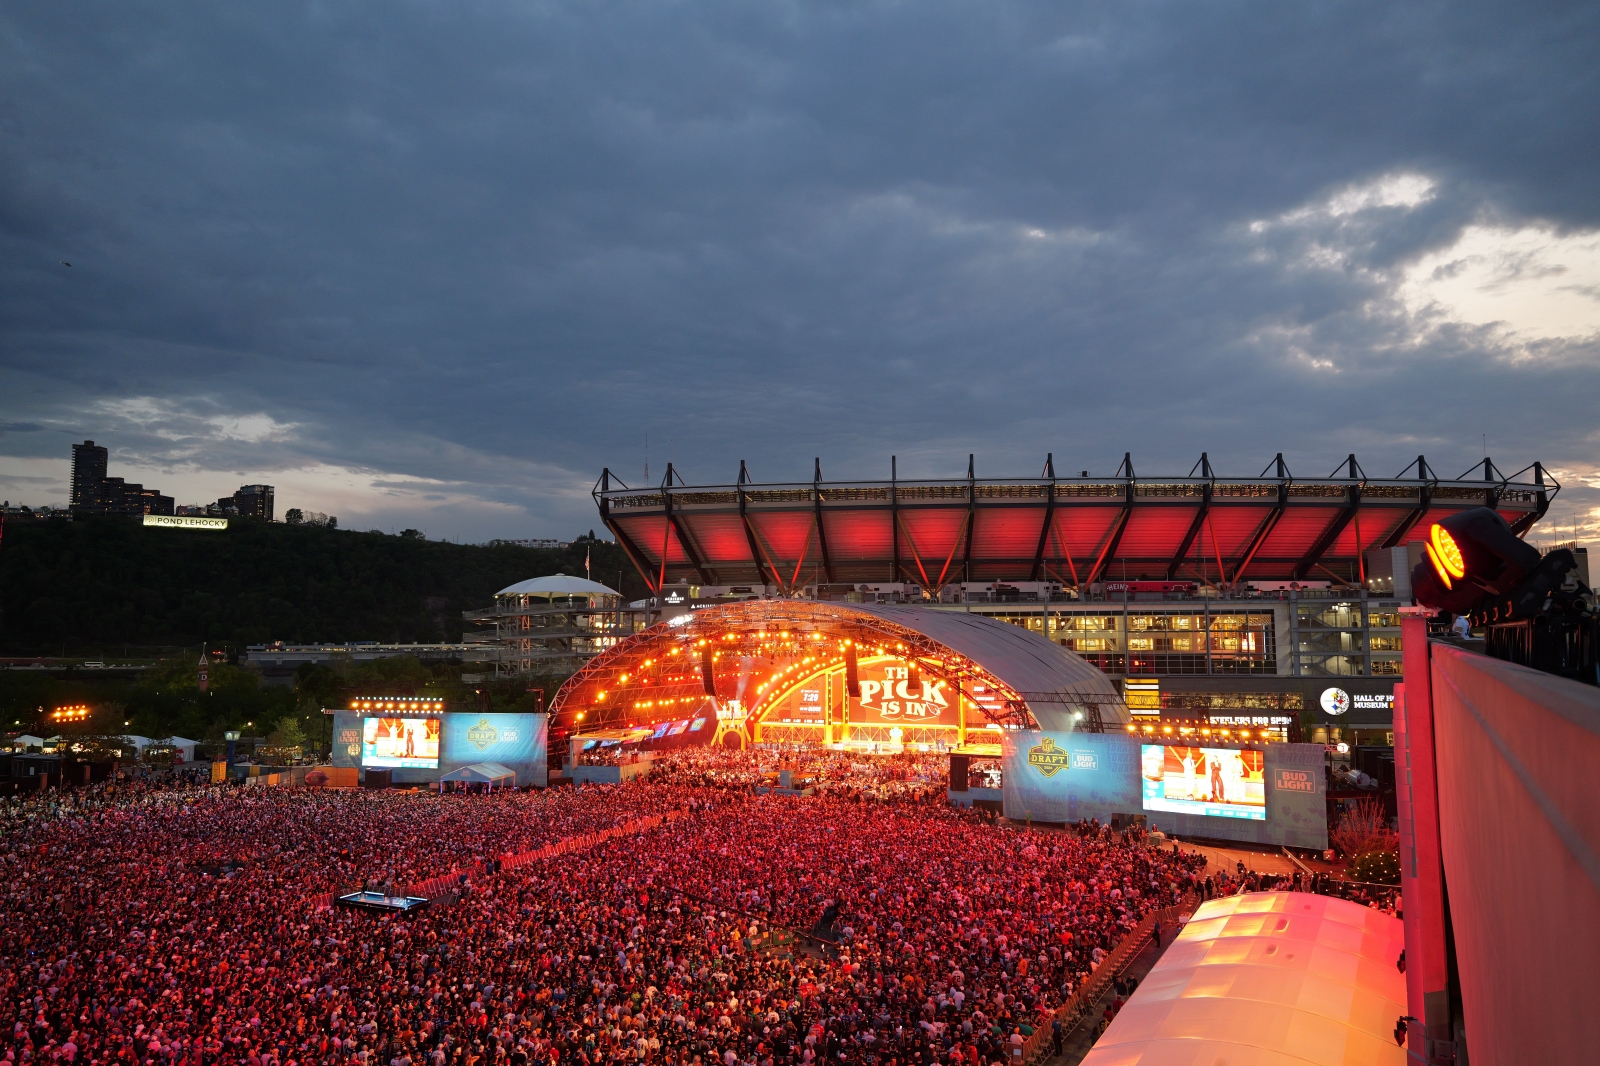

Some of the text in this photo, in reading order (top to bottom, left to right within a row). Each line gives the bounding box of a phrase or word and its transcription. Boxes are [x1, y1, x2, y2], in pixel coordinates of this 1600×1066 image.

[157, 517, 226, 527] POND LEHOCKY
[884, 667, 909, 680] TH
[859, 680, 949, 708] PICK
[1353, 694, 1374, 702] HALL
[880, 701, 927, 717] IS IN
[1209, 716, 1250, 725] STEELERS
[1252, 716, 1269, 725] PRO
[339, 735, 360, 743] LIGHT
[469, 732, 496, 740] DRAFT
[1031, 754, 1065, 764] DRAFT
[1073, 760, 1096, 769] LIGHT
[1281, 771, 1308, 782] BUD
[1277, 780, 1313, 791] LIGHT
